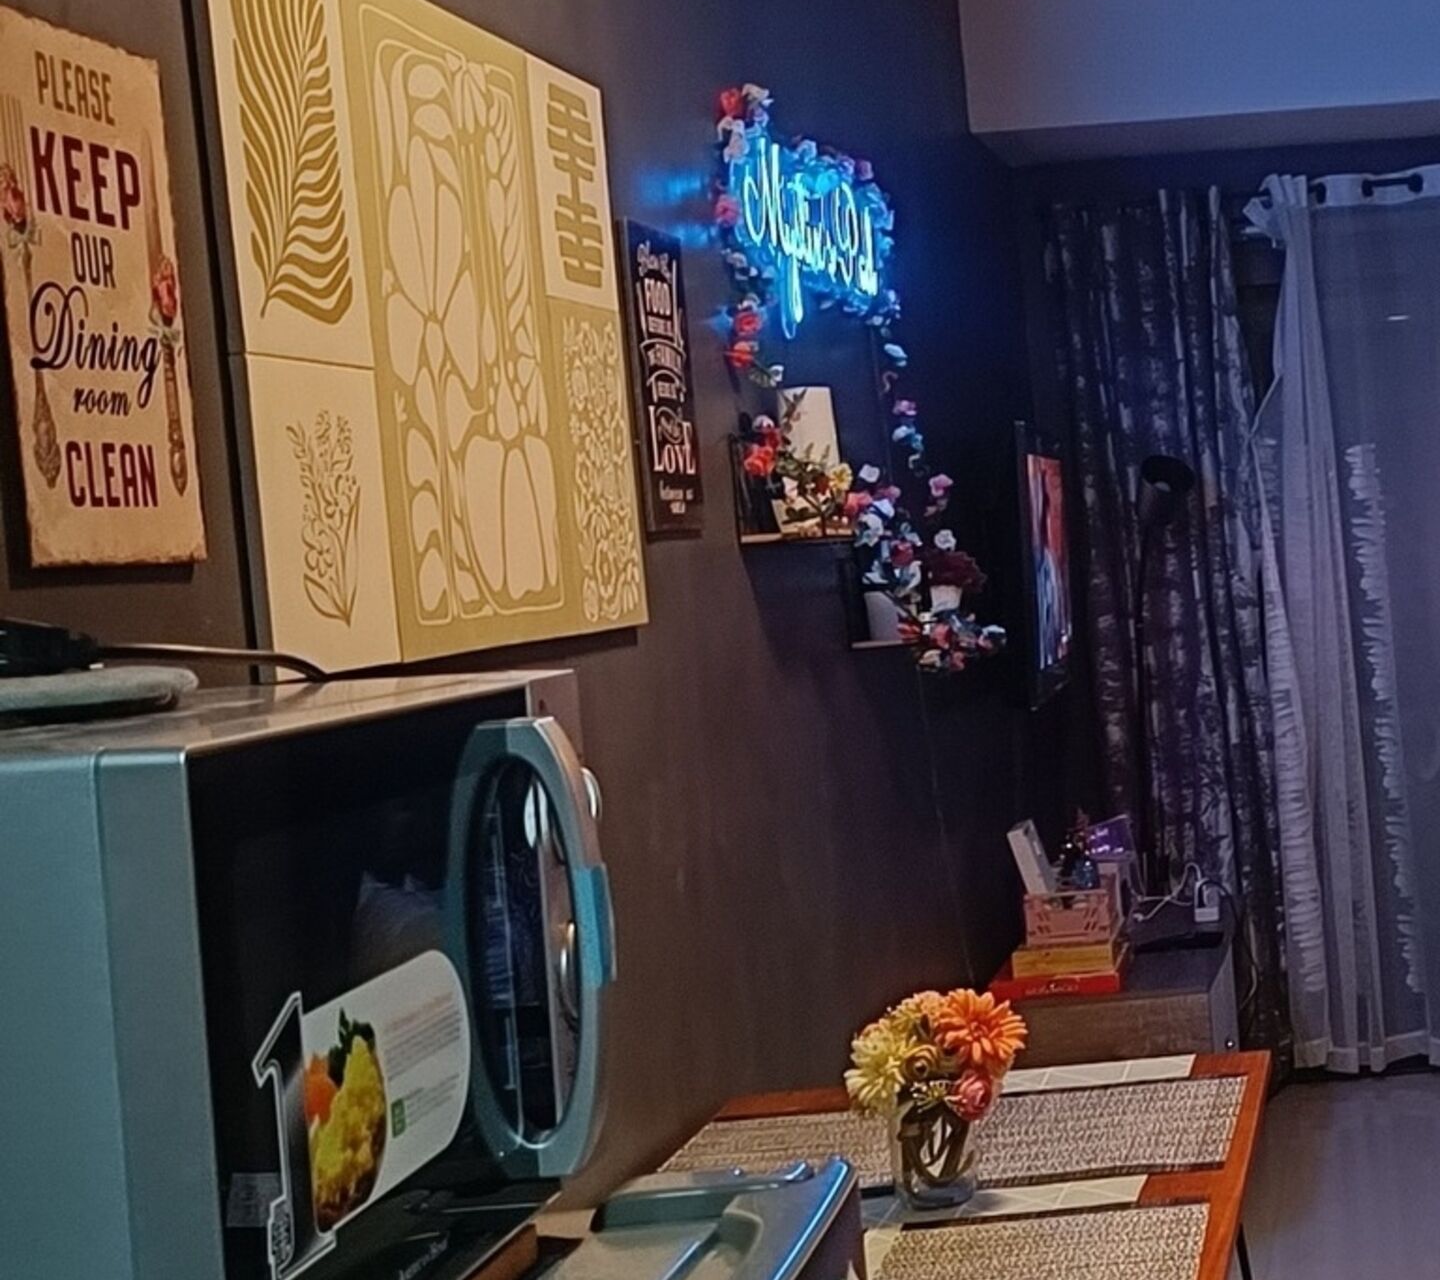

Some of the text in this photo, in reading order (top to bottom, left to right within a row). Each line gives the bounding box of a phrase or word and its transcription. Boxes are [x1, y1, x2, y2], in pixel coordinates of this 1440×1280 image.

[34, 50, 116, 127] PLEASE
[30, 125, 142, 231] KEEP
[71, 231, 117, 289] OUR
[643, 278, 673, 316] FOOD
[29, 281, 160, 407] Dining
[72, 382, 133, 417] room
[65, 440, 159, 509] CLEAN
[648, 405, 696, 475] LOVE
